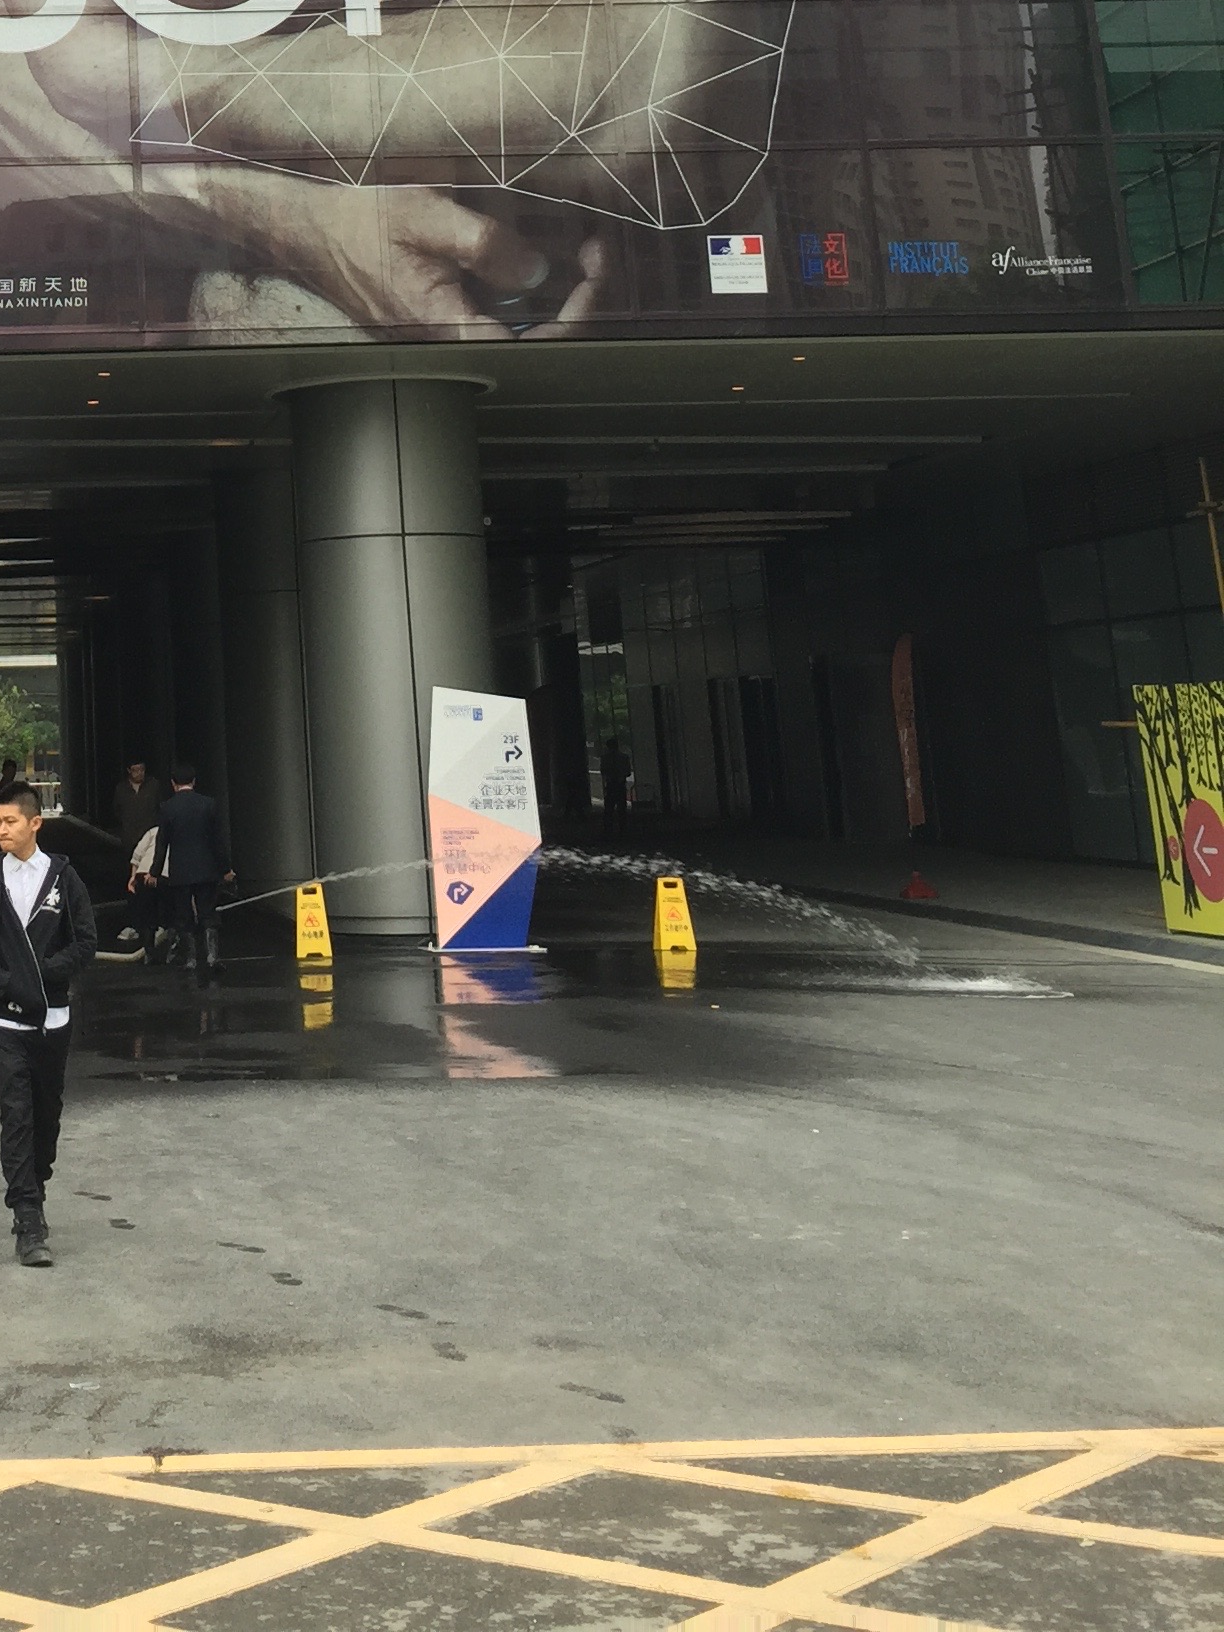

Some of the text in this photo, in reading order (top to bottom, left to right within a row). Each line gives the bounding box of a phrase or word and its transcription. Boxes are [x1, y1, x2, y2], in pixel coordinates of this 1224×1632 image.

[887, 241, 960, 259] INSTITUT
[16, 297, 88, 308] XINTIANDI
[503, 734, 520, 744] 23F
